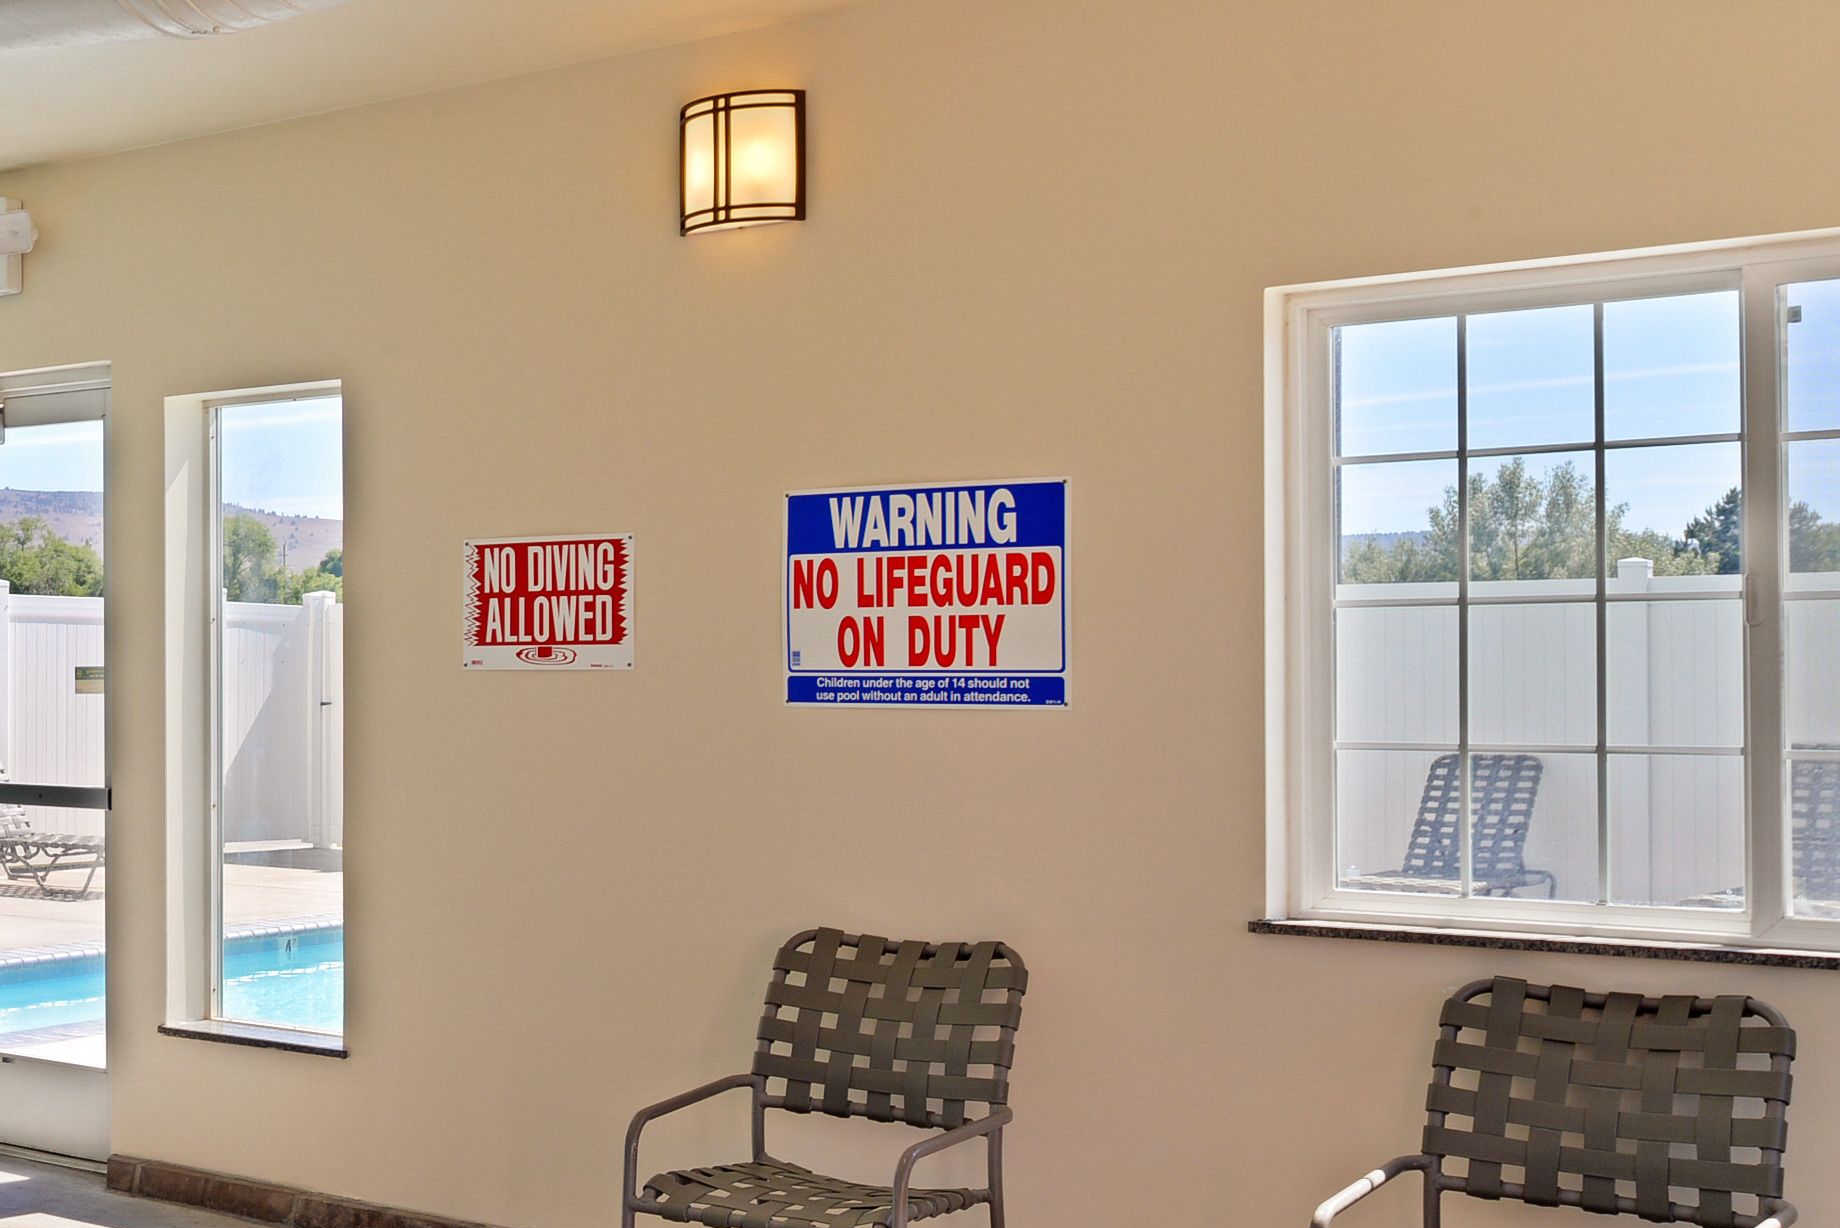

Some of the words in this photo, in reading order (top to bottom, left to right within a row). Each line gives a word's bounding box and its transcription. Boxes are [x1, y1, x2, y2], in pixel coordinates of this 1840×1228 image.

[828, 488, 1018, 549] WARNING
[483, 546, 516, 594] NO
[527, 541, 615, 592] DIVING
[793, 557, 840, 609] NO
[857, 551, 1056, 608] LIFEGUARD
[485, 594, 613, 643] ALLOWED
[837, 615, 885, 668] ON
[908, 614, 1006, 668] DUTY
[816, 677, 860, 688] Children
[862, 678, 894, 688] under
[895, 678, 913, 688] the
[915, 679, 935, 690] age
[938, 678, 950, 688] of
[951, 678, 966, 689] 14
[967, 678, 1008, 689] should
[1010, 679, 1030, 689] not
[816, 692, 835, 701] use
[837, 690, 860, 703] pool
[861, 691, 902, 701] without
[904, 693, 918, 702] an
[920, 691, 948, 702] adult
[950, 691, 961, 702] in
[963, 691, 1032, 703] attendance.
